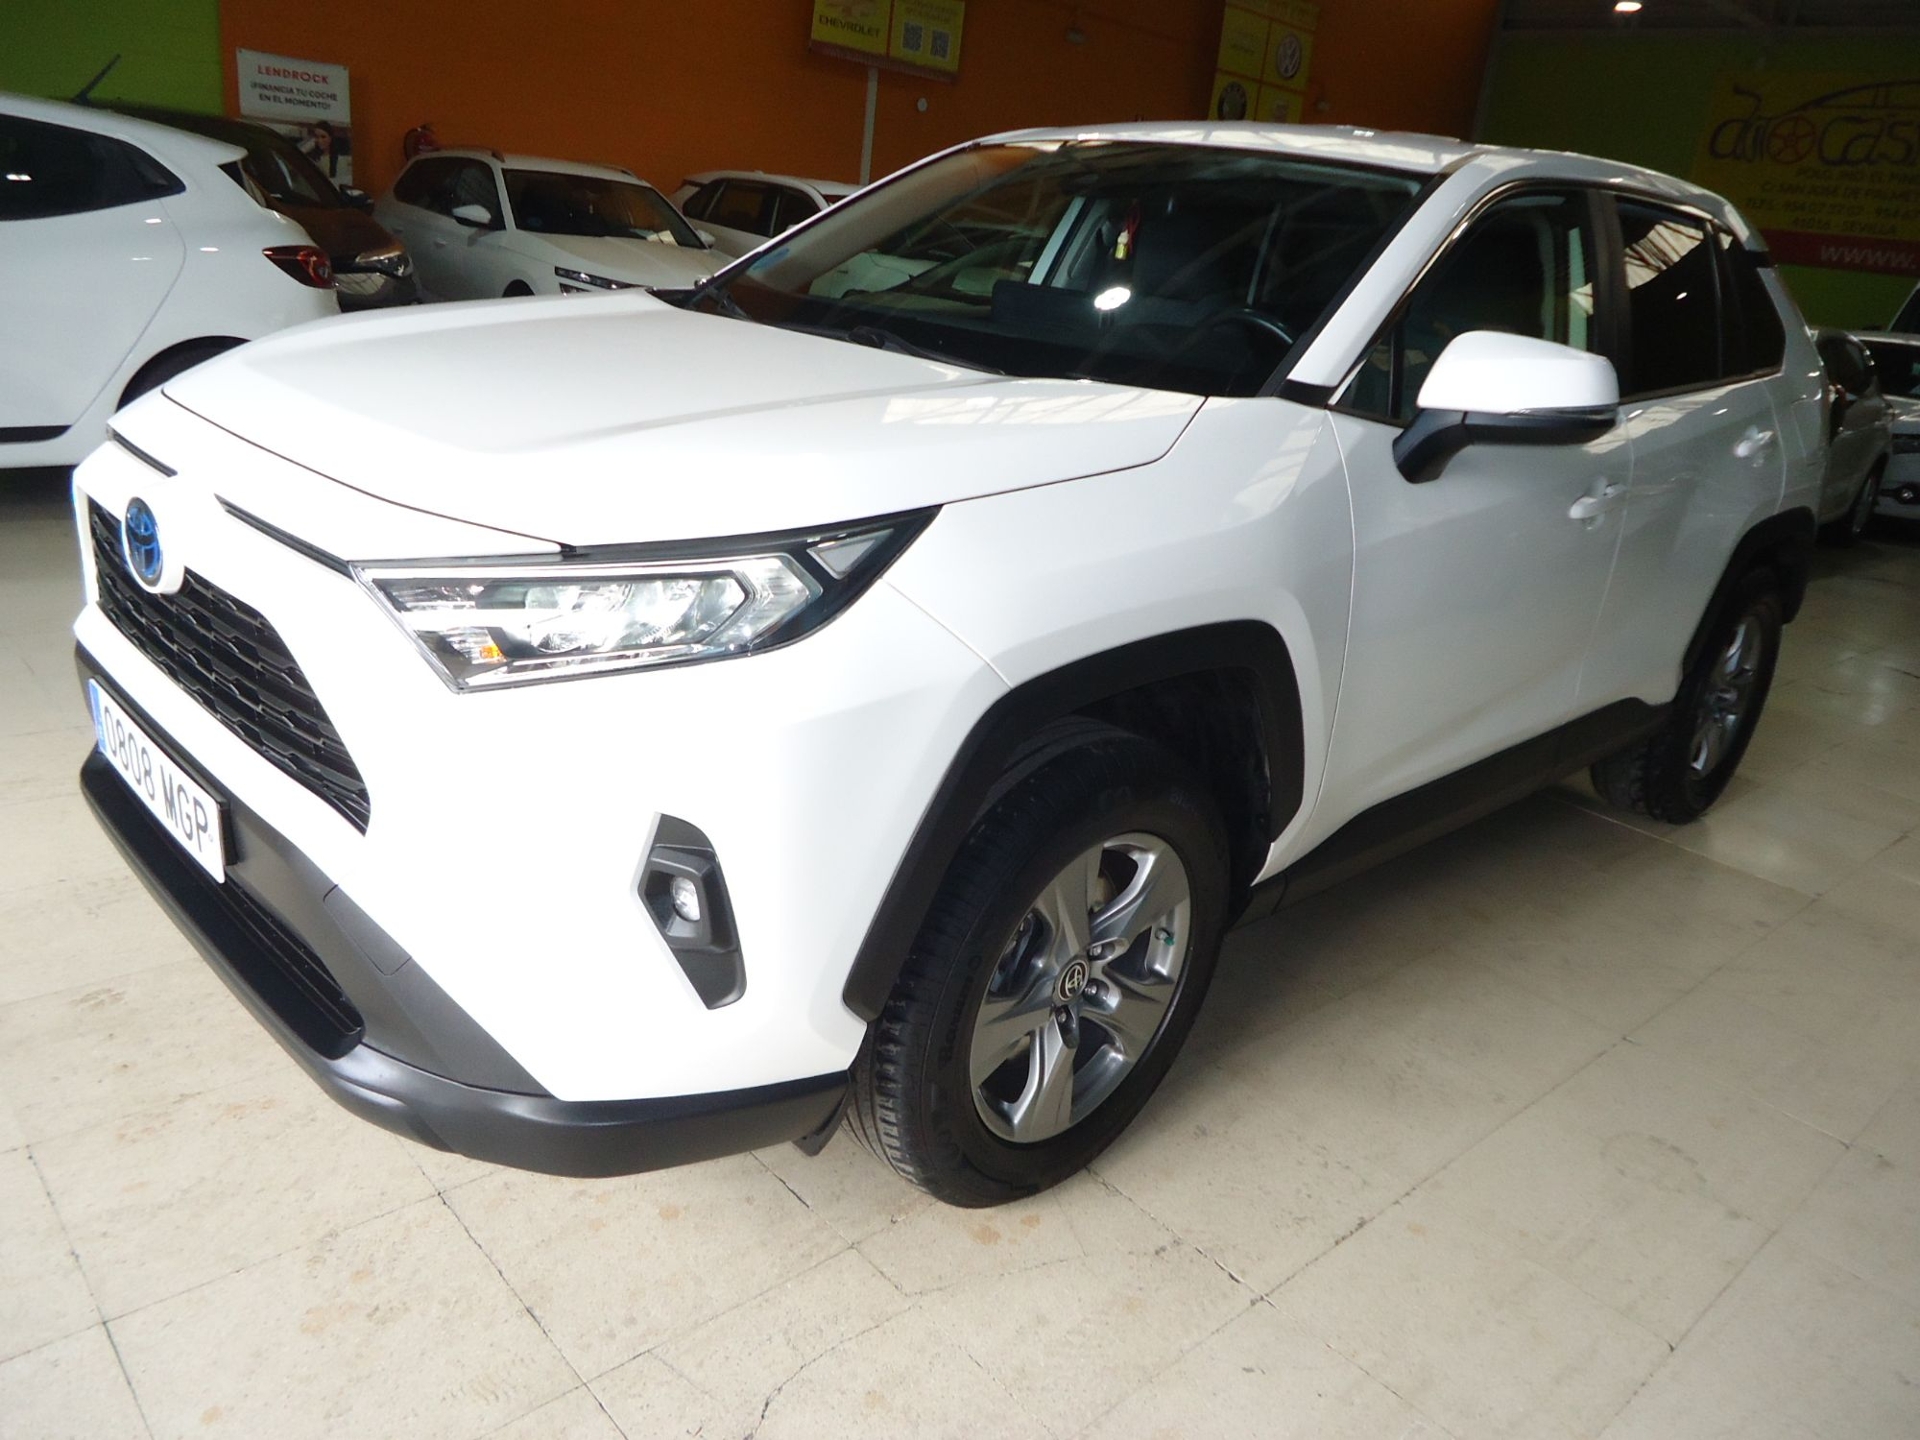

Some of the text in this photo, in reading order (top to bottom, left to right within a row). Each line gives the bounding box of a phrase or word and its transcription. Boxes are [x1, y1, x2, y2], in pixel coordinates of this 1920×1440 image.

[818, 14, 881, 38] CHEVROLET
[257, 64, 329, 85] LENDROCK
[259, 93, 331, 110] EN EL MOMENTO!
[295, 88, 308, 97] TU
[308, 90, 338, 102] COCHE
[103, 705, 209, 853] 0808 MGP
